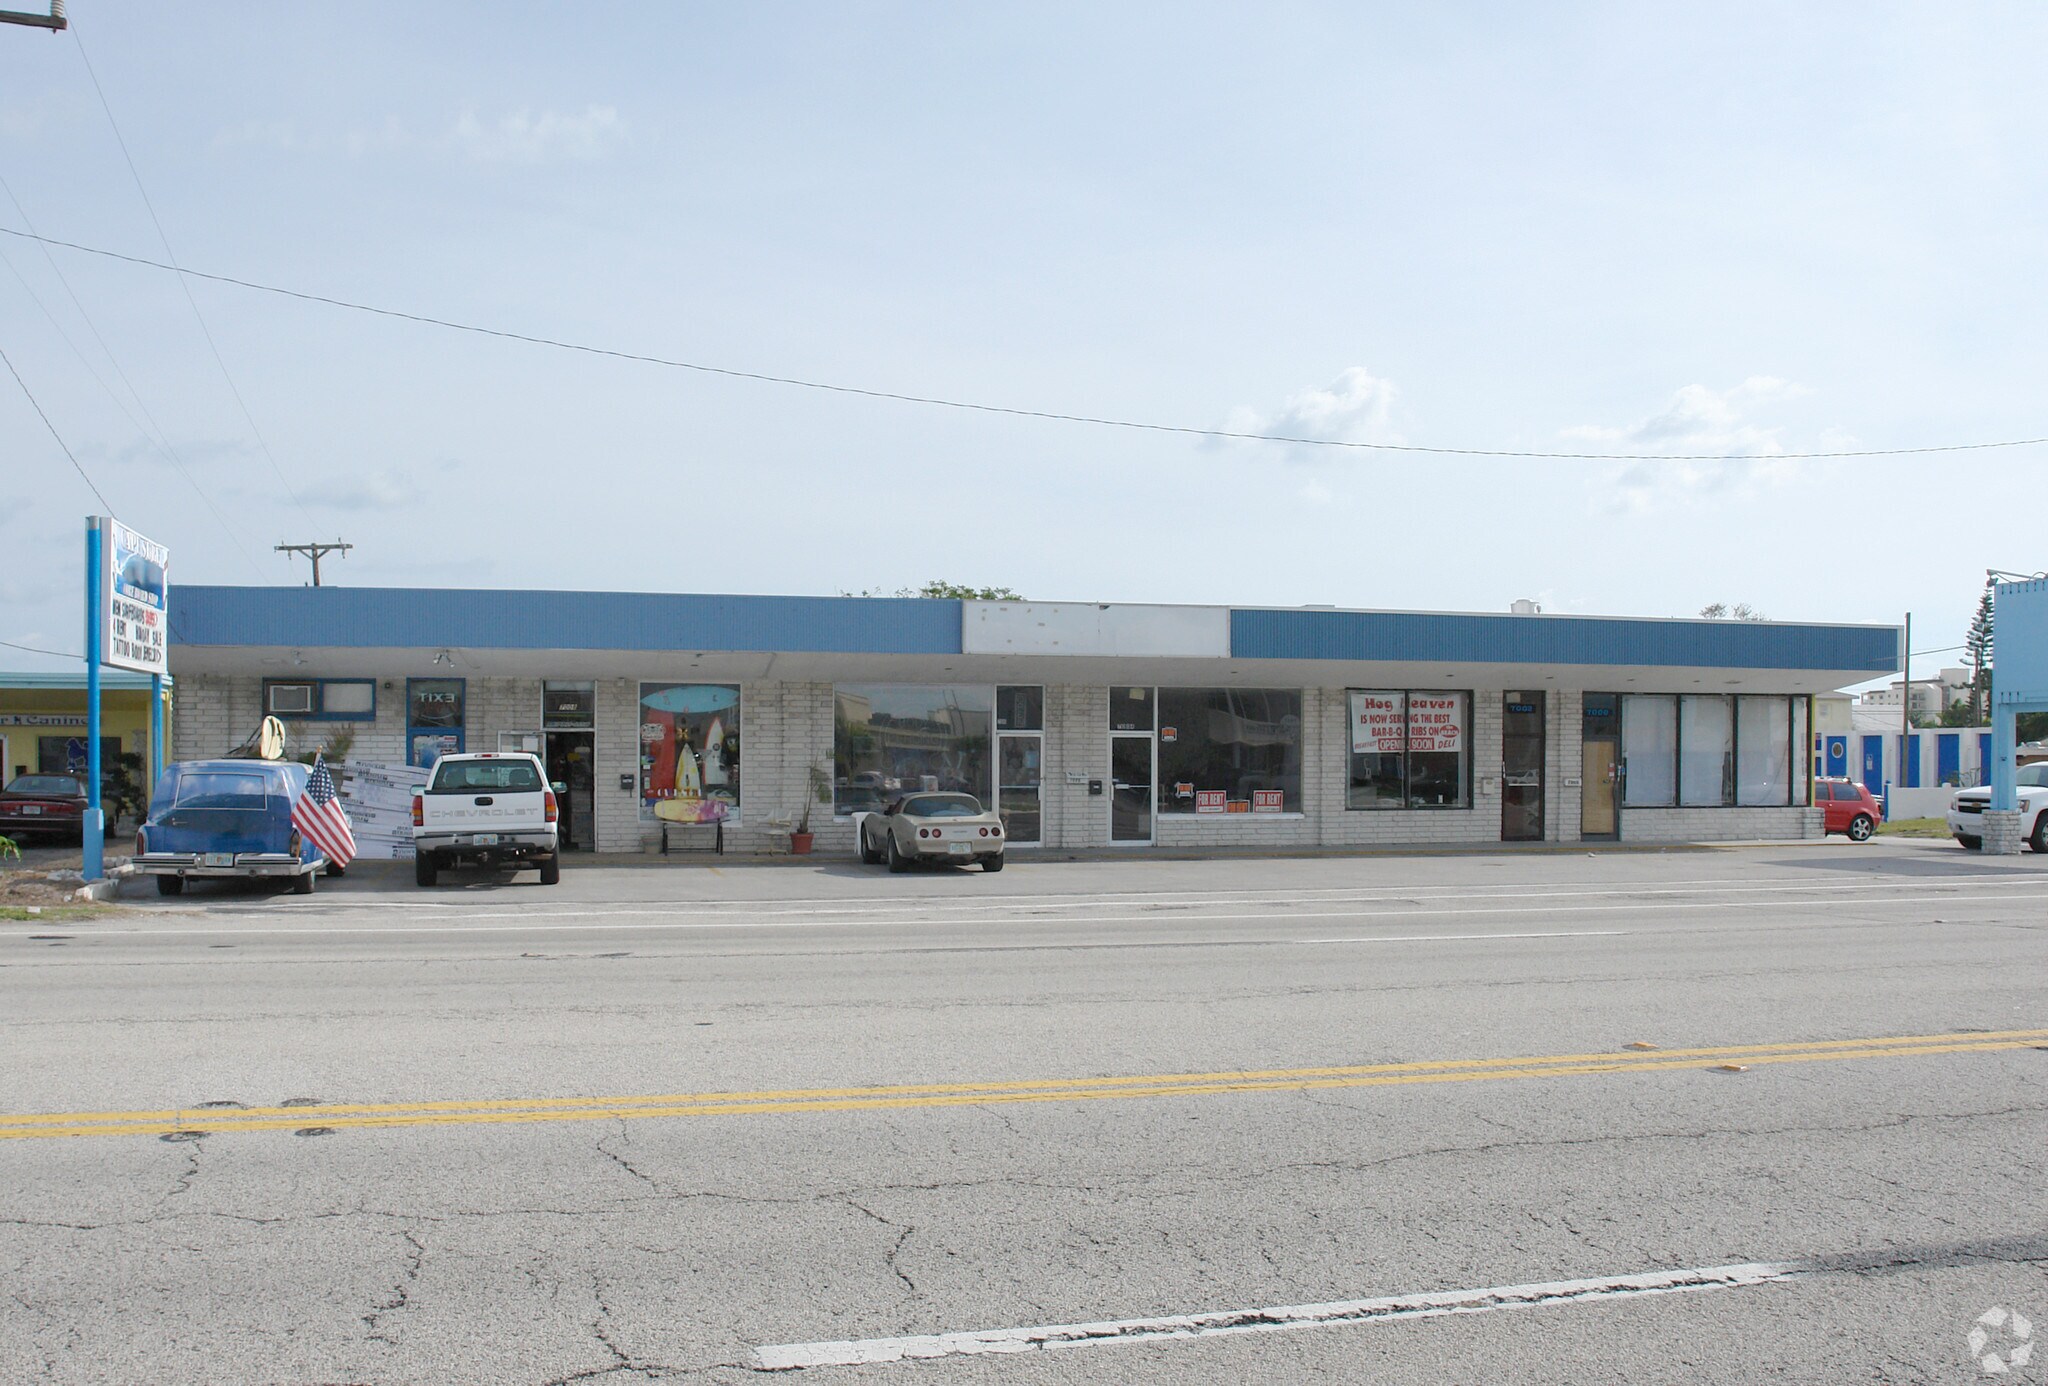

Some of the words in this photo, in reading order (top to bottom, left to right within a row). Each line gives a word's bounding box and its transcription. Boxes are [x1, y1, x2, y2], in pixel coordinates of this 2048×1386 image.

[113, 637, 130, 657] TATTOO
[1365, 697, 1394, 712] Hog
[1360, 714, 1368, 724] IS
[1369, 714, 1388, 724] NOW
[1420, 713, 1432, 723] THE
[1434, 713, 1451, 723] BEST
[1410, 726, 1427, 736] RIBS
[1428, 726, 1440, 736] ON
[1411, 738, 1434, 750] SOON
[1437, 739, 1456, 749] DELI
[1198, 793, 1208, 805] FOR
[1209, 793, 1224, 805] RENT
[1256, 793, 1266, 805] FOR
[1266, 793, 1281, 805] RENT
[429, 807, 539, 818] CHEVROLET
